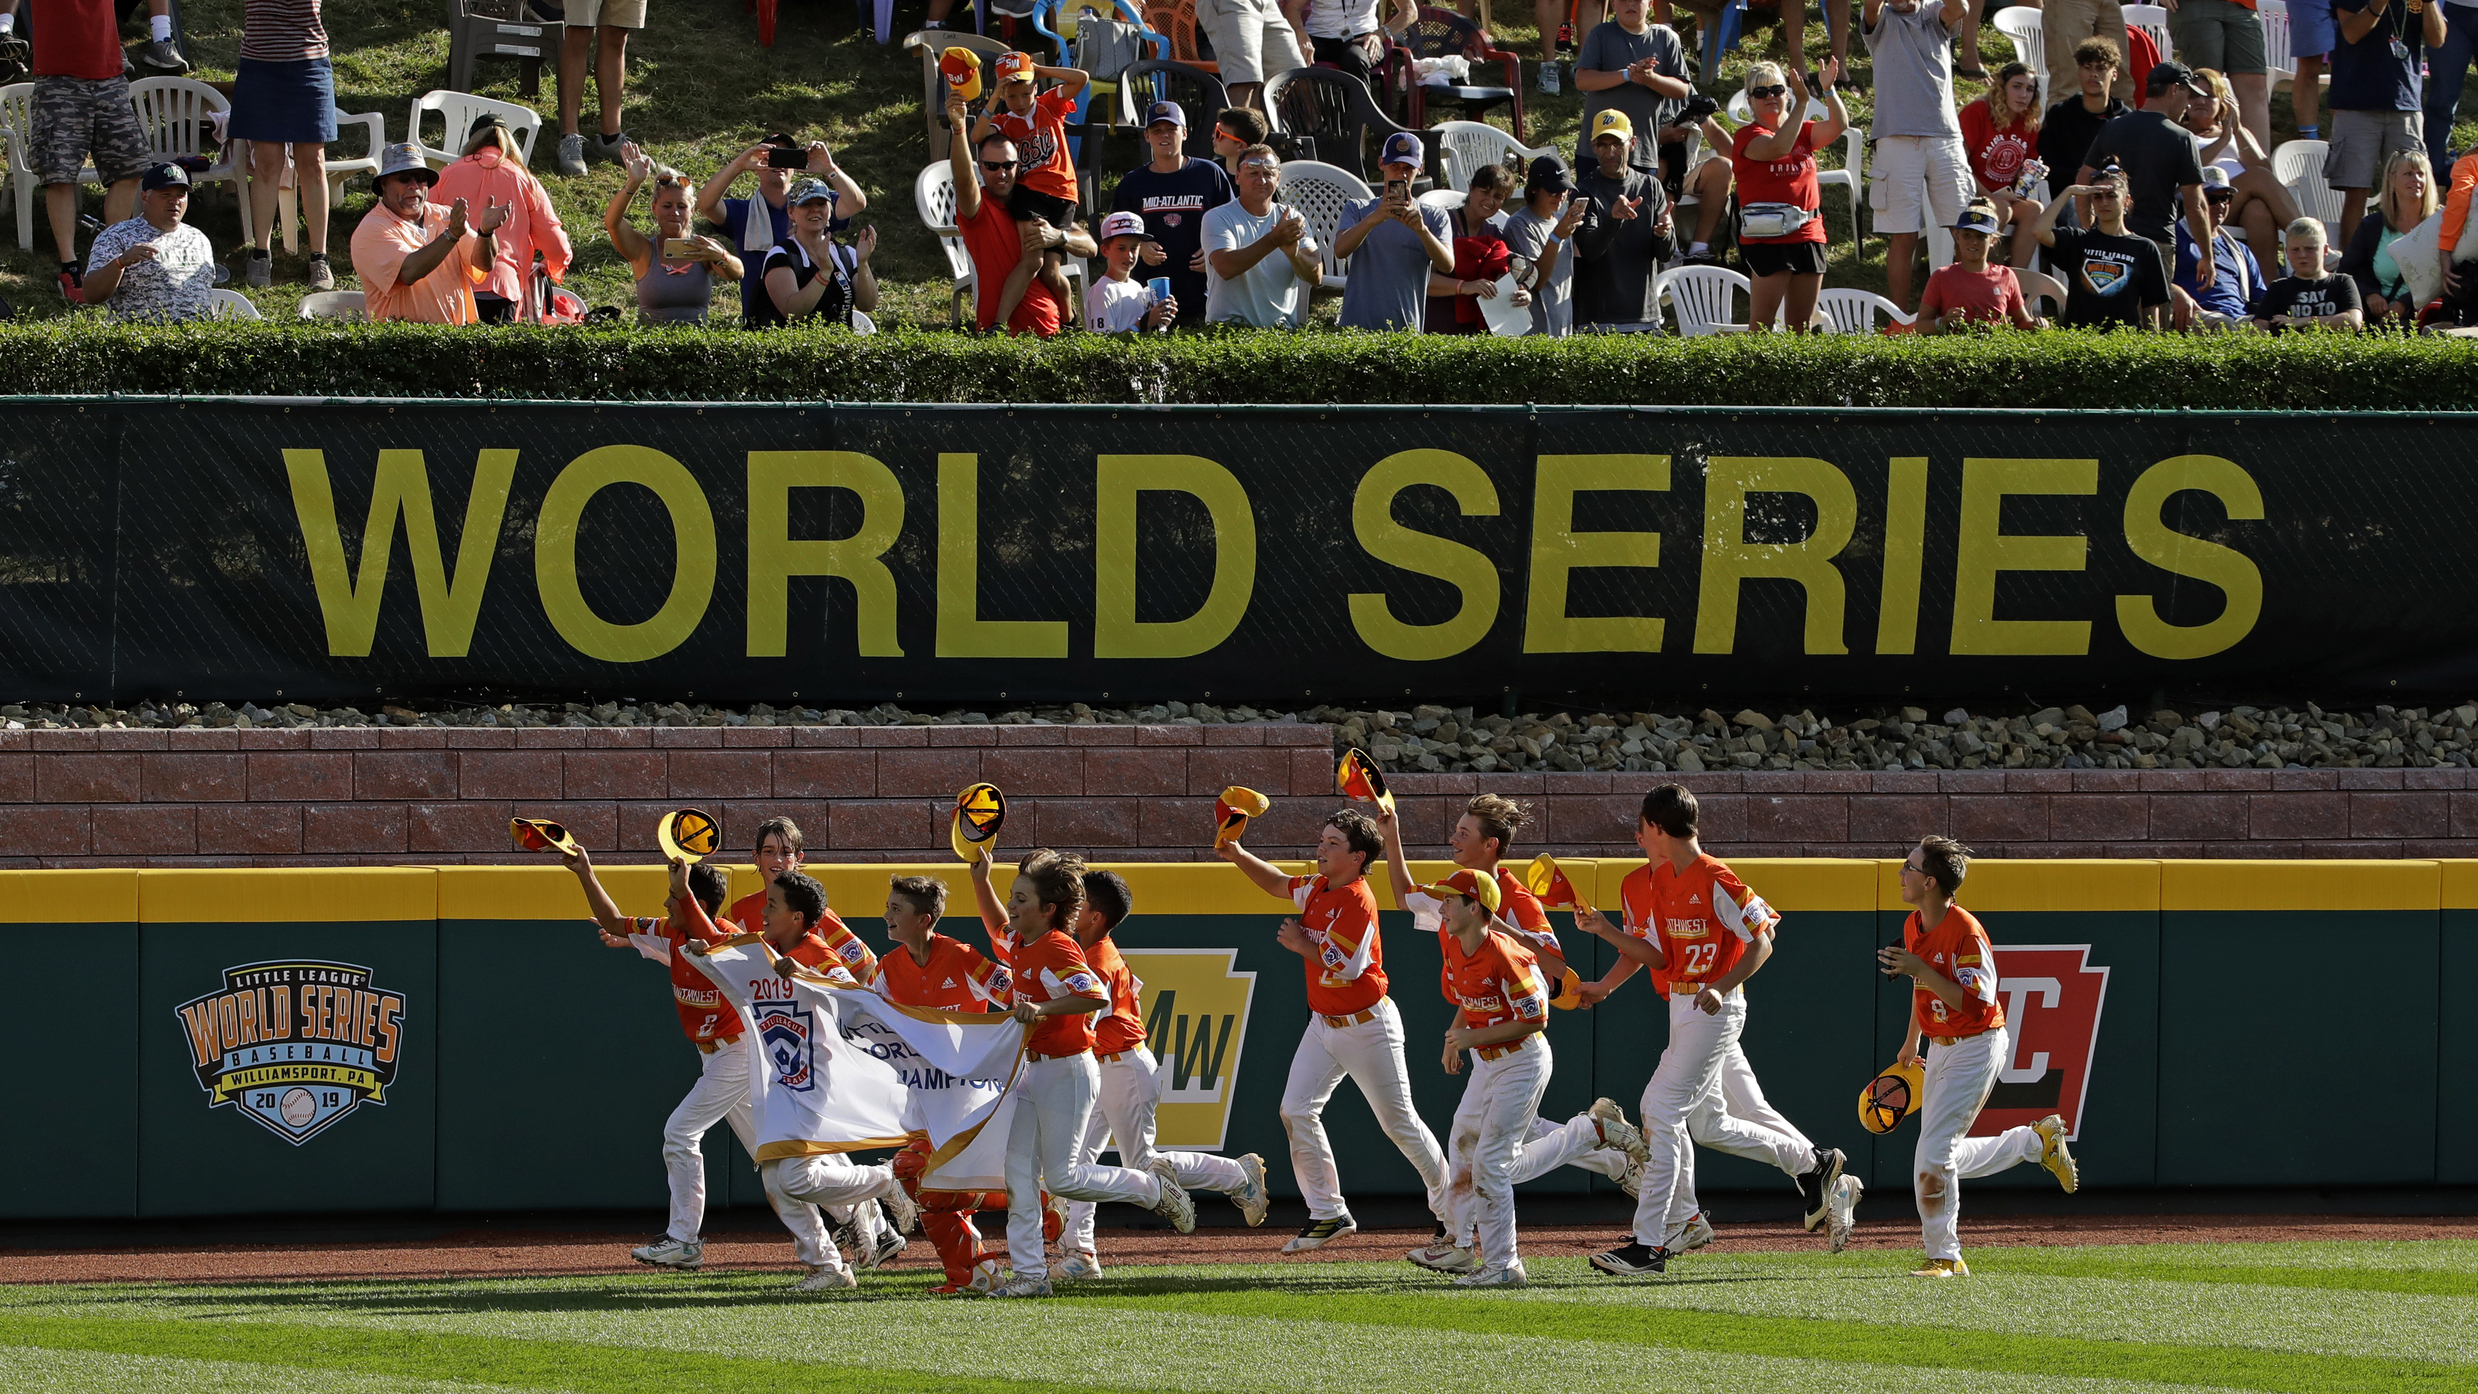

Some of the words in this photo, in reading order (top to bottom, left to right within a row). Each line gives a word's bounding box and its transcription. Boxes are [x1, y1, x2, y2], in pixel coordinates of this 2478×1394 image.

[1142, 195, 1204, 209] MID-ATLANTIC
[2084, 248, 2106, 257] LITTLE
[2108, 251, 2135, 263] LEAGUE
[2298, 288, 2327, 304] SAY
[2290, 304, 2312, 317] NO
[2315, 301, 2336, 316] TO
[281, 444, 1257, 662] WORLD
[1347, 448, 2266, 661] SERIES
[1685, 943, 1717, 974] 23
[236, 970, 291, 988] LITTLE
[749, 978, 794, 1001] 2019
[180, 984, 291, 1067] WORLD
[300, 984, 401, 1063] SERIES
[231, 1045, 365, 1067] BASEBALL
[347, 1070, 366, 1085] PA
[256, 1093, 276, 1109] 20
[322, 1092, 340, 1108] 19
